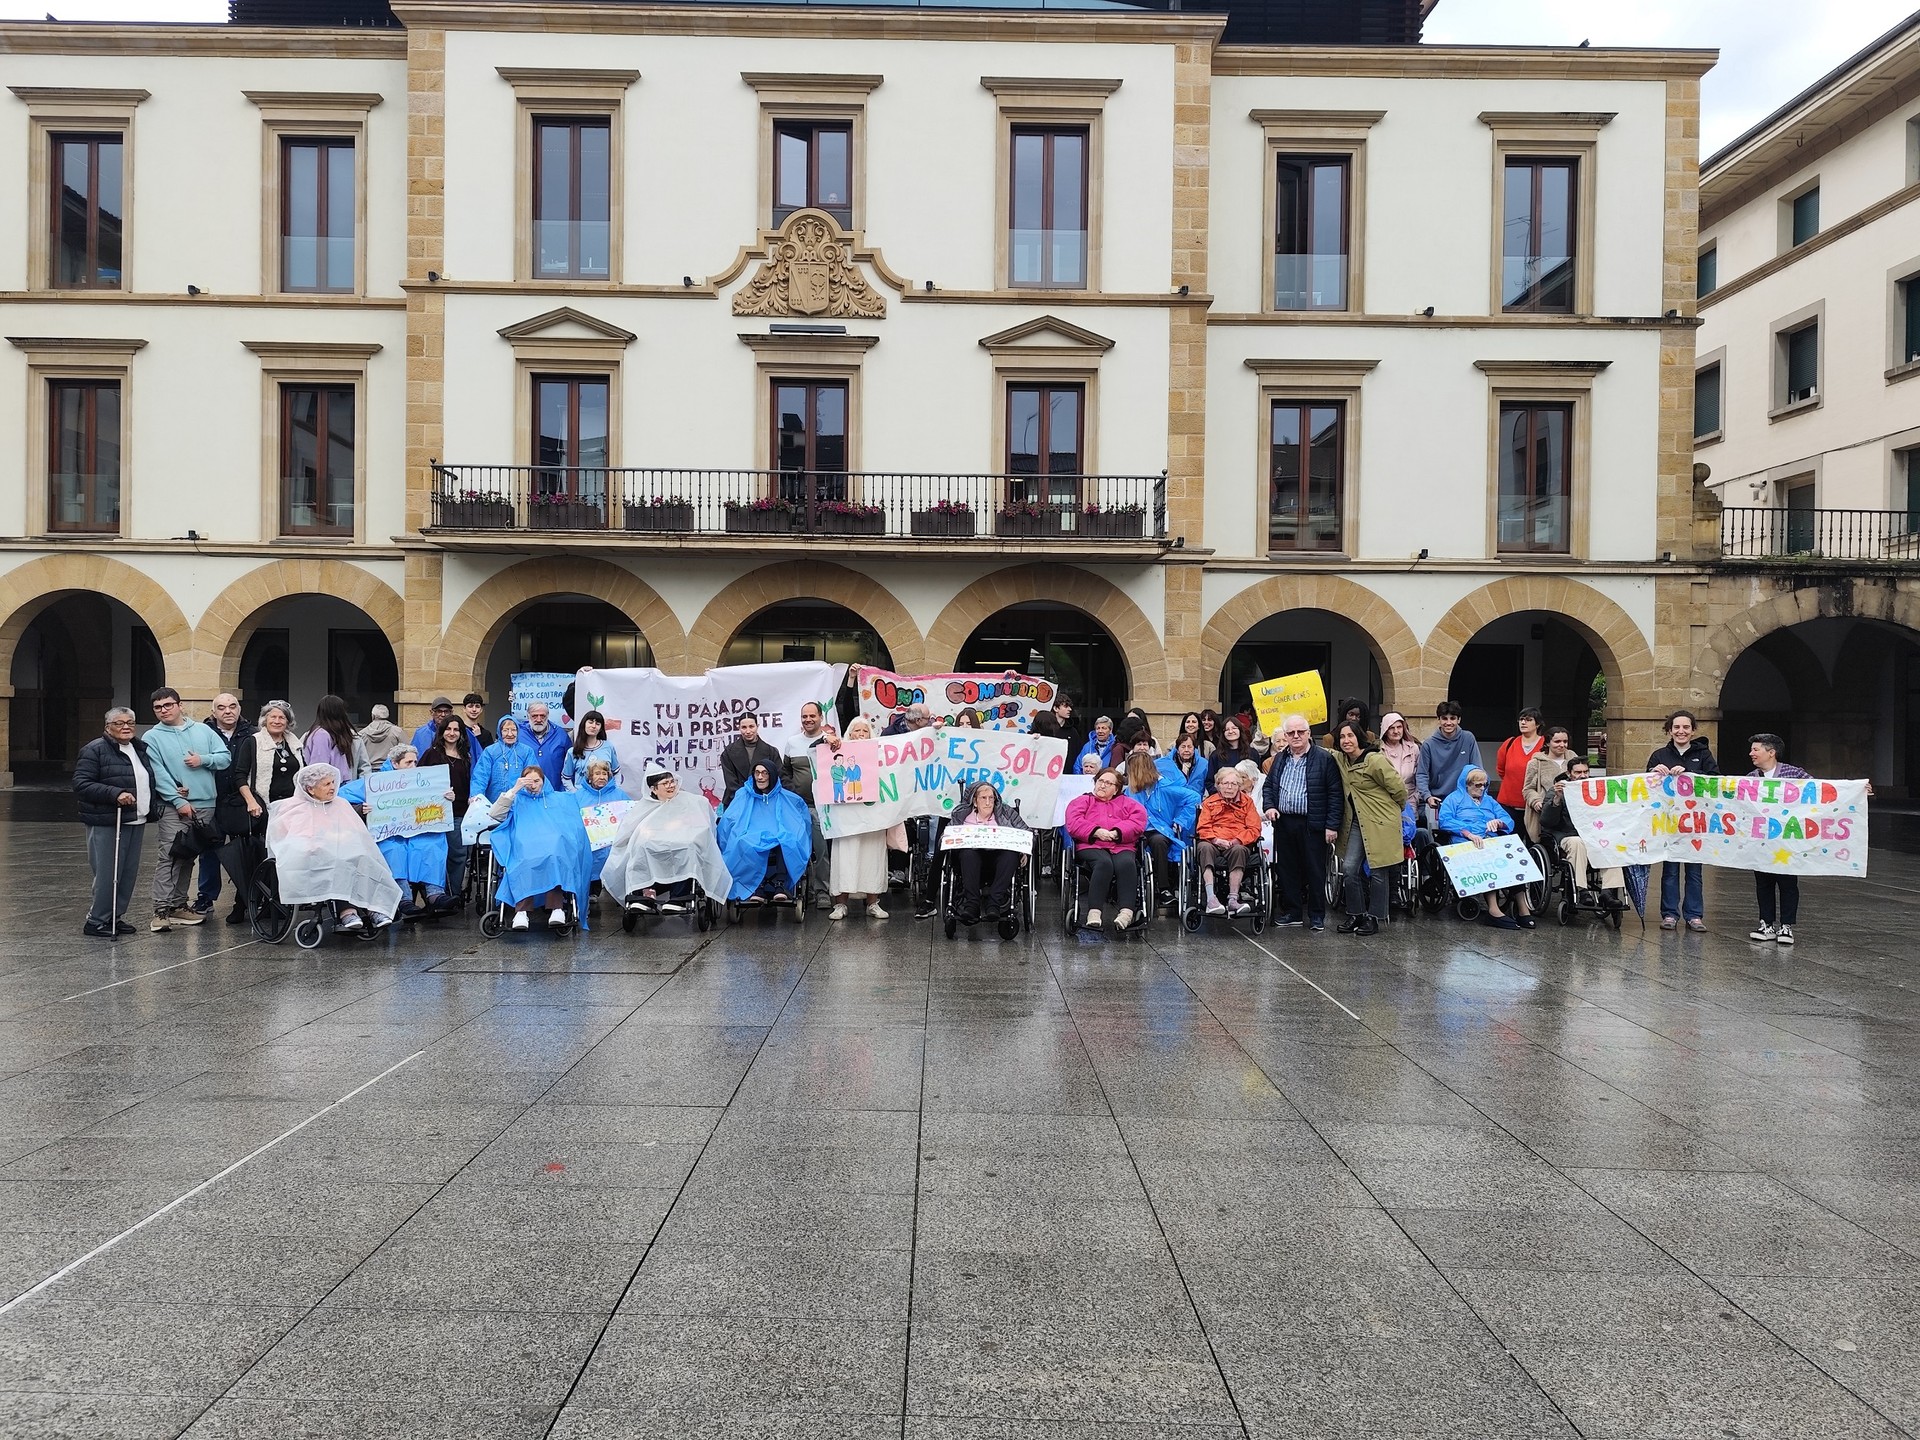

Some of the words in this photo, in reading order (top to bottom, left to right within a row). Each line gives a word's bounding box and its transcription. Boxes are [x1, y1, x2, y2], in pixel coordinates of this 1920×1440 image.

[945, 680, 1054, 704] COMUNIDAD
[513, 702, 521, 710] EN
[654, 703, 680, 720] TU
[688, 697, 760, 719] PASADO
[976, 701, 1020, 723] DADES
[631, 720, 650, 736] ES
[657, 722, 683, 737] MI
[690, 713, 783, 737] PRESETE
[656, 739, 678, 755] MI
[688, 734, 742, 754] FUTUR
[673, 756, 698, 771] TU
[948, 737, 986, 764] ES
[997, 743, 1064, 780] SOLO
[369, 773, 410, 793] Cuando
[416, 772, 431, 787] las
[872, 773, 899, 805] N
[914, 756, 1005, 795] NÚMERO
[1581, 776, 1649, 807] UNA
[1662, 774, 1838, 805] COMUNIDAD
[1652, 811, 1736, 836] MUCHAS
[1751, 815, 1854, 841] EDADES
